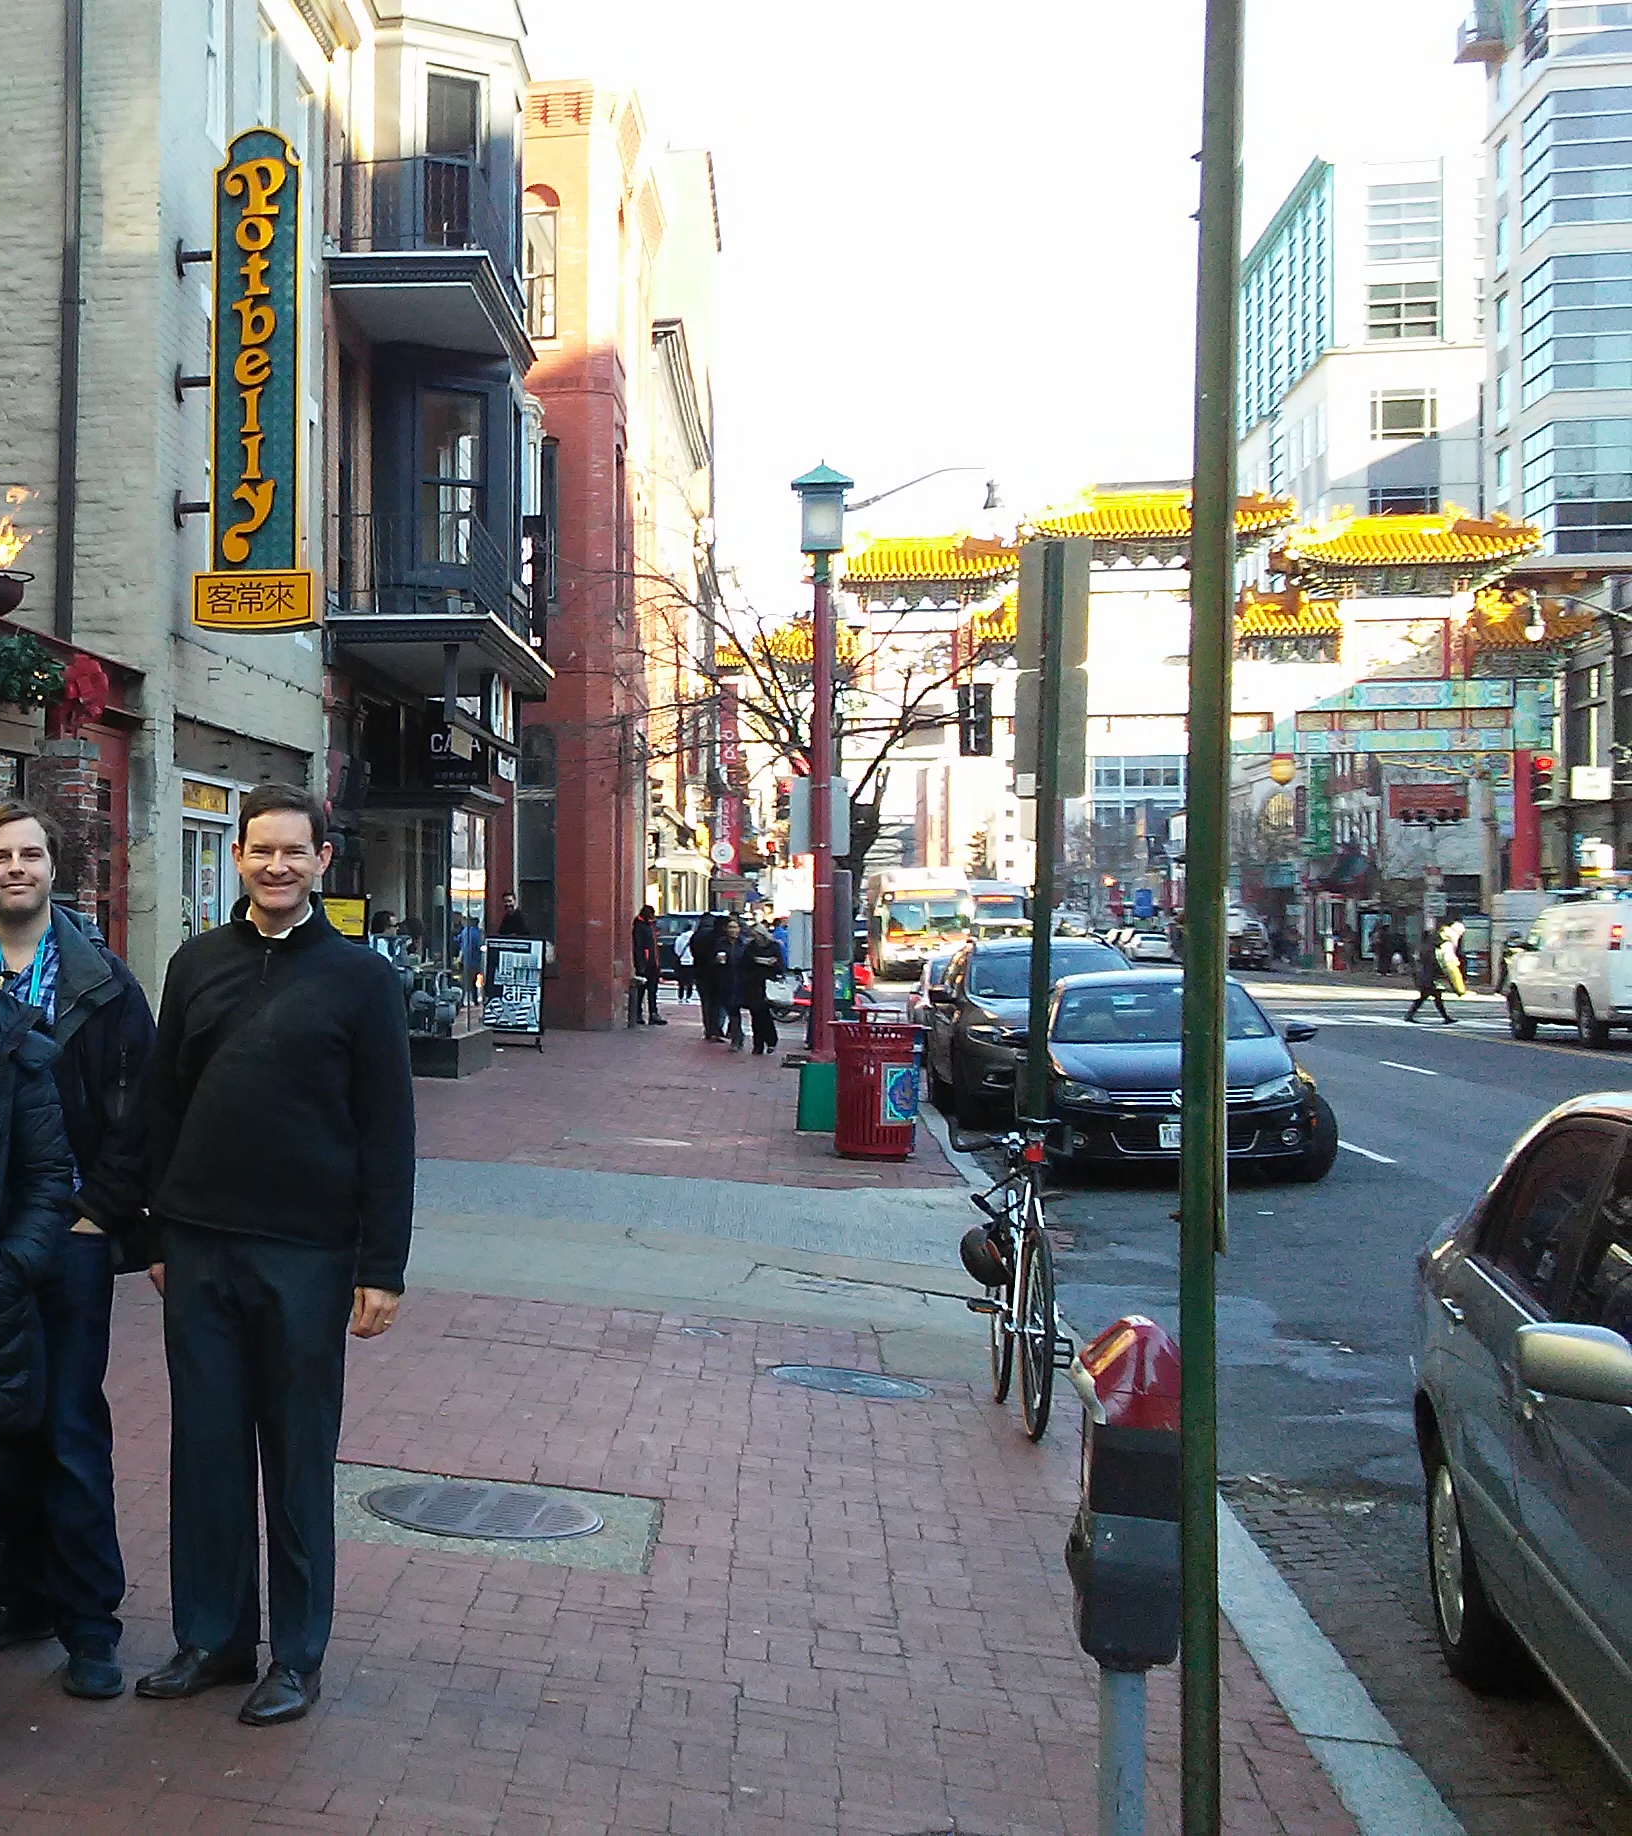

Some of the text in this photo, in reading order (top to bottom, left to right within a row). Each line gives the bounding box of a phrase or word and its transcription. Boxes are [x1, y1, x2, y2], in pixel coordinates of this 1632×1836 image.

[222, 157, 286, 563] Potbelly
[206, 581, 295, 614] 客常來
[504, 992, 537, 1002] GIFT
